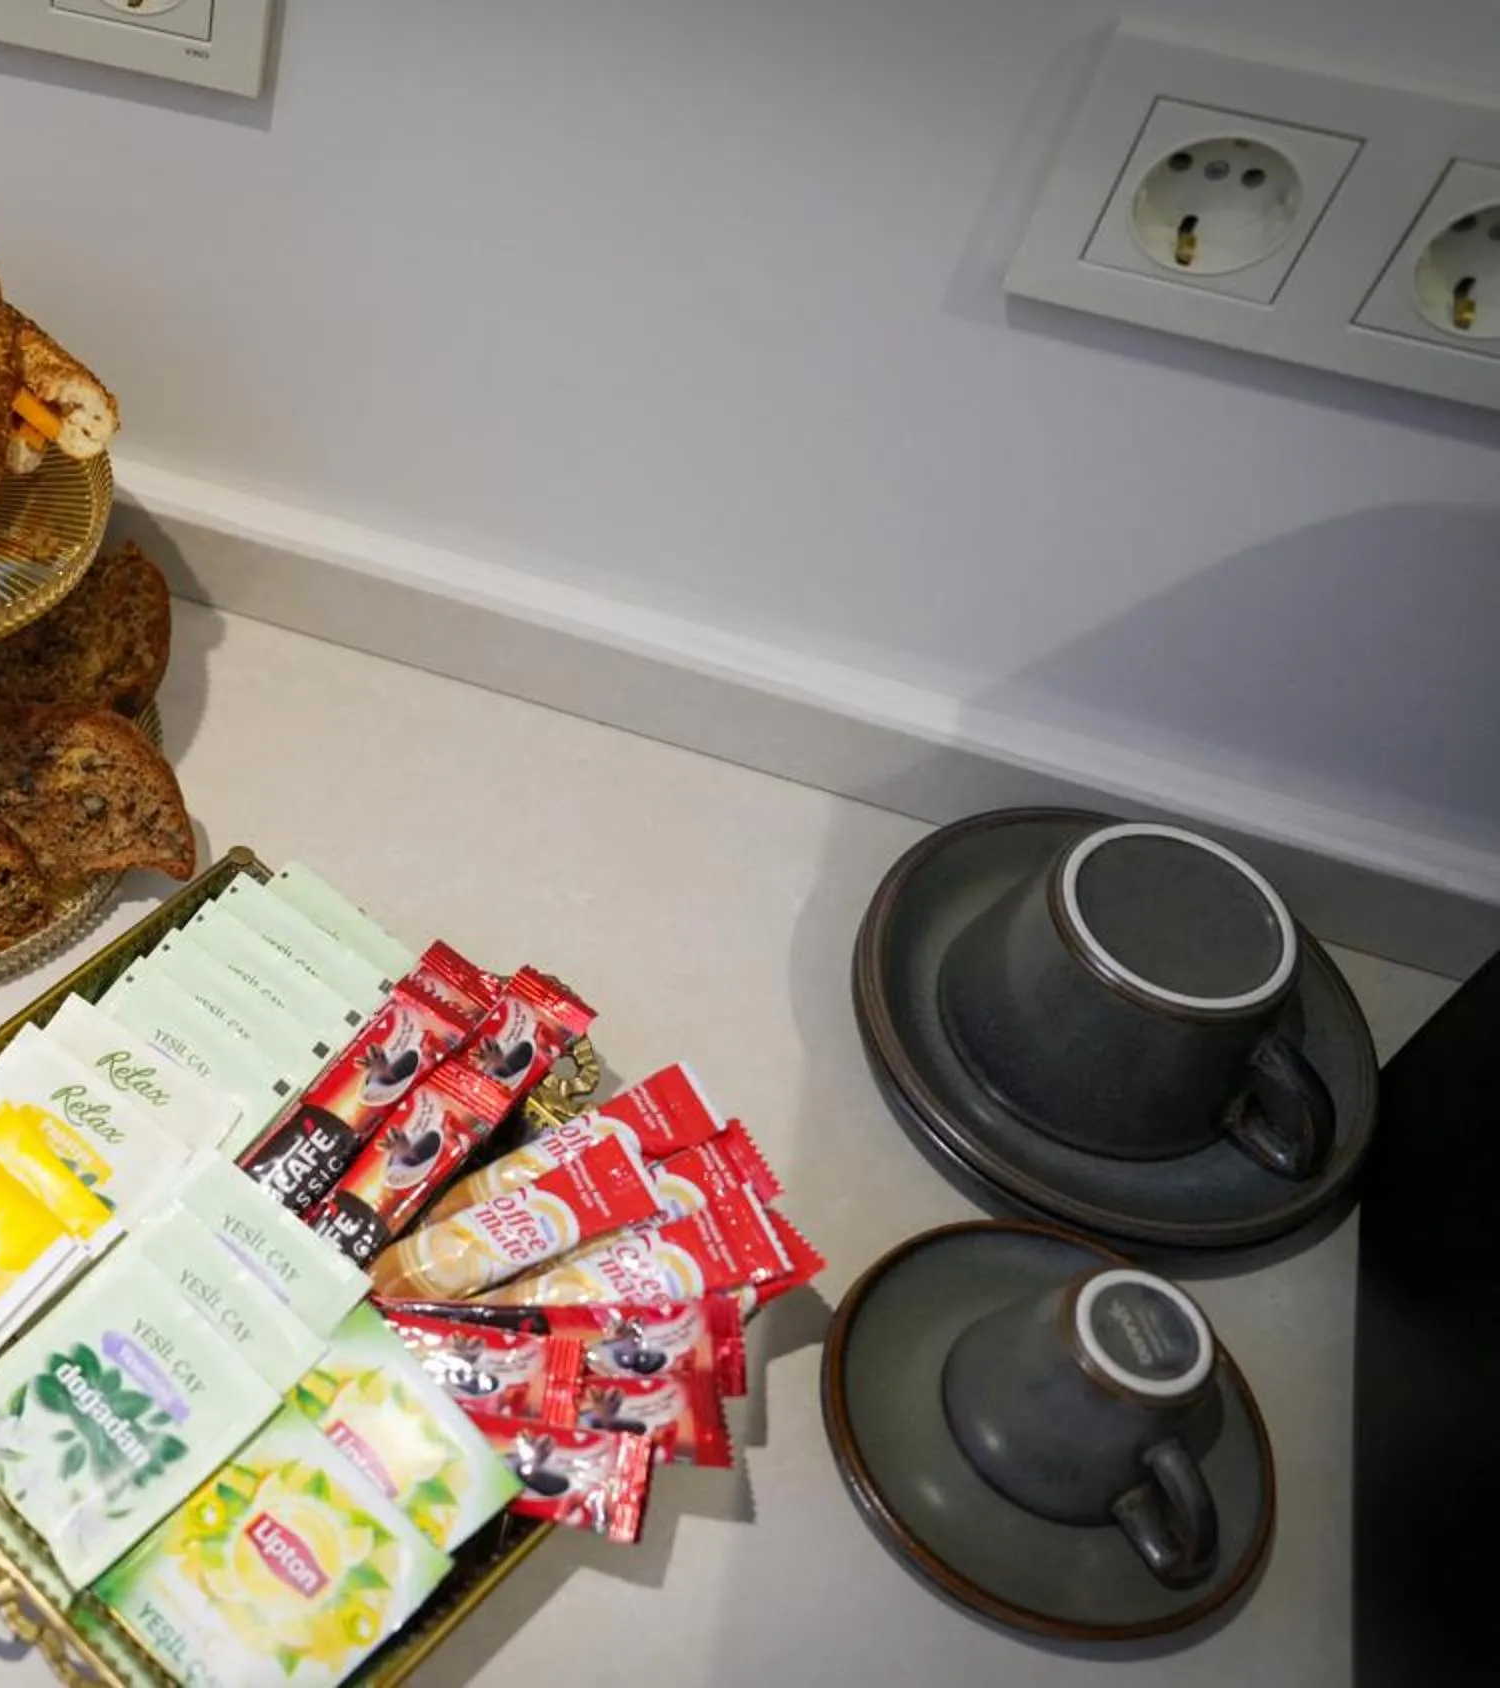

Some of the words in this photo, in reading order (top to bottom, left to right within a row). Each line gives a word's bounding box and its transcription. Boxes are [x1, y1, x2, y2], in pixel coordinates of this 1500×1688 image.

[95, 1050, 171, 1106] Relax
[50, 1085, 126, 1144] Relax
[252, 1518, 319, 1592] Lipton
